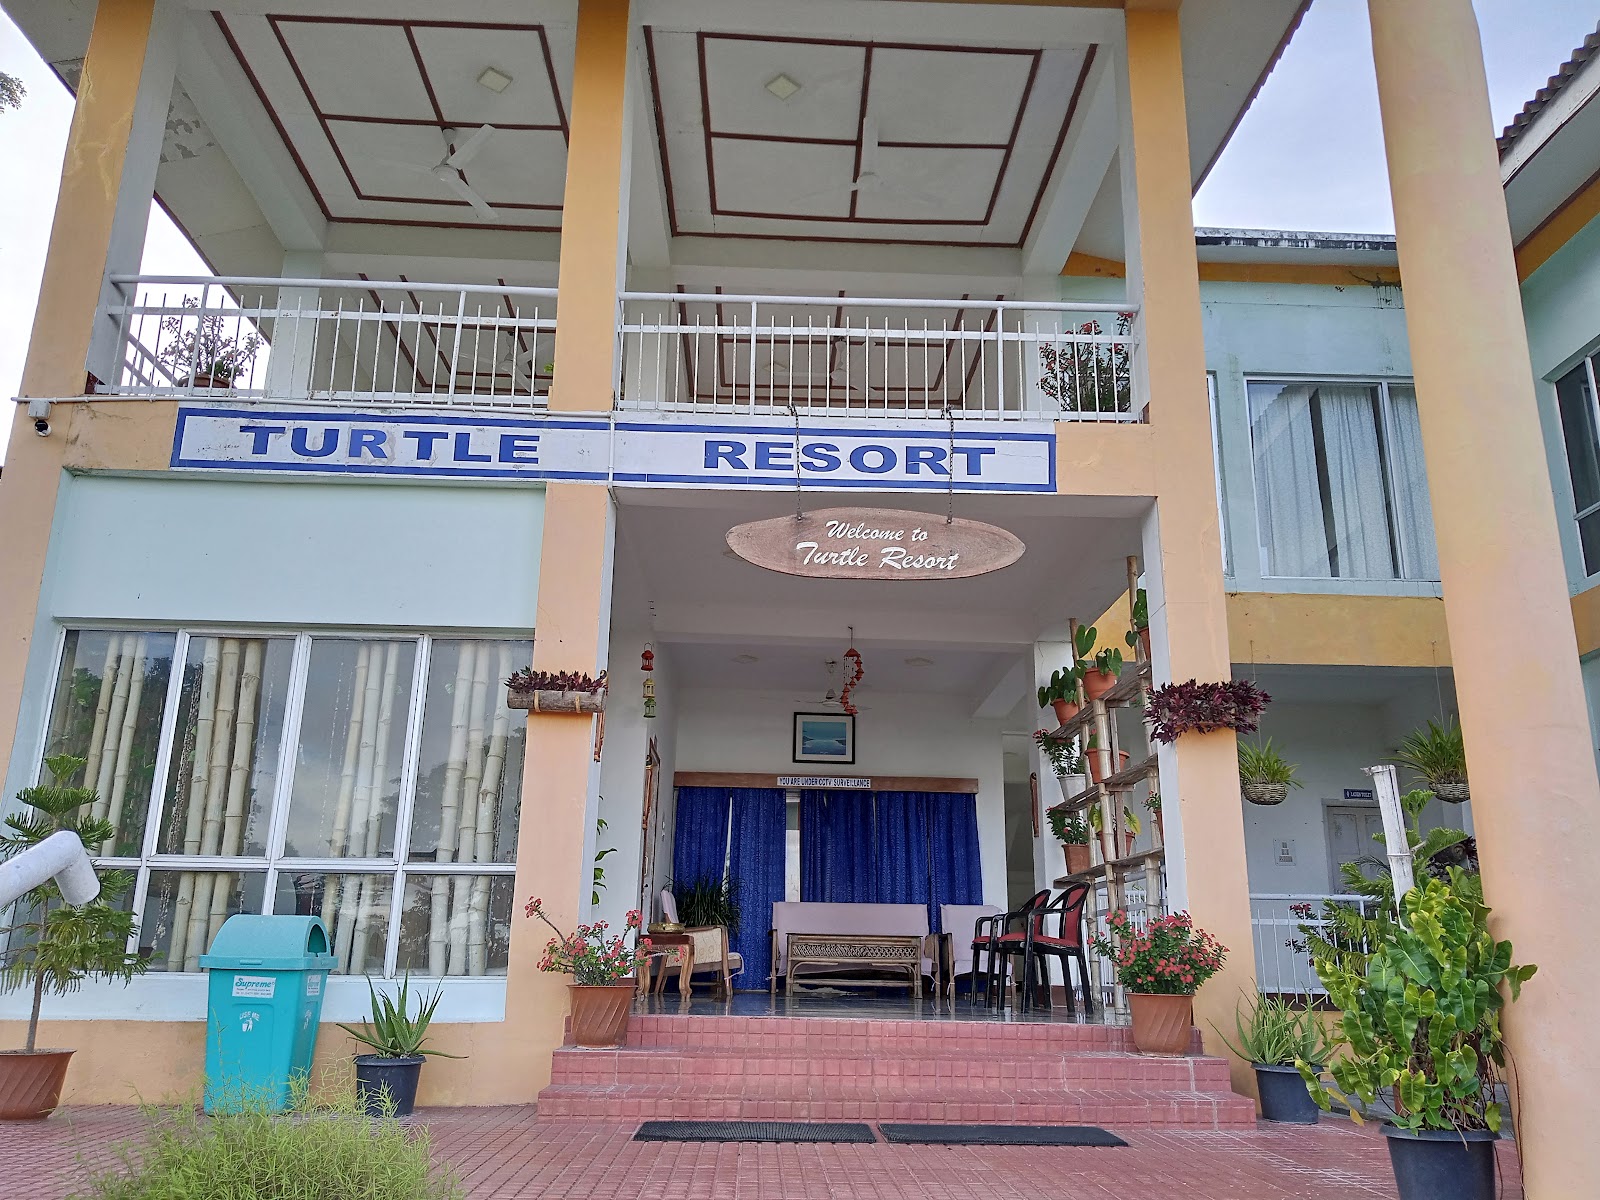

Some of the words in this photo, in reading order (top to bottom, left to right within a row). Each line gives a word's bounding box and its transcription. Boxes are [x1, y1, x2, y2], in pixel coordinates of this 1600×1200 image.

[239, 425, 541, 465] TURTLE
[703, 440, 996, 476] RESORT
[825, 520, 905, 542] Welcome
[911, 526, 929, 542] to
[795, 541, 869, 567] Turtle
[879, 546, 960, 571] Resort
[780, 777, 790, 786] YOU
[790, 777, 800, 786] ARE
[801, 777, 818, 787] UNDER
[833, 778, 870, 788] SURVEILLANCE
[235, 977, 272, 990] Supreme
